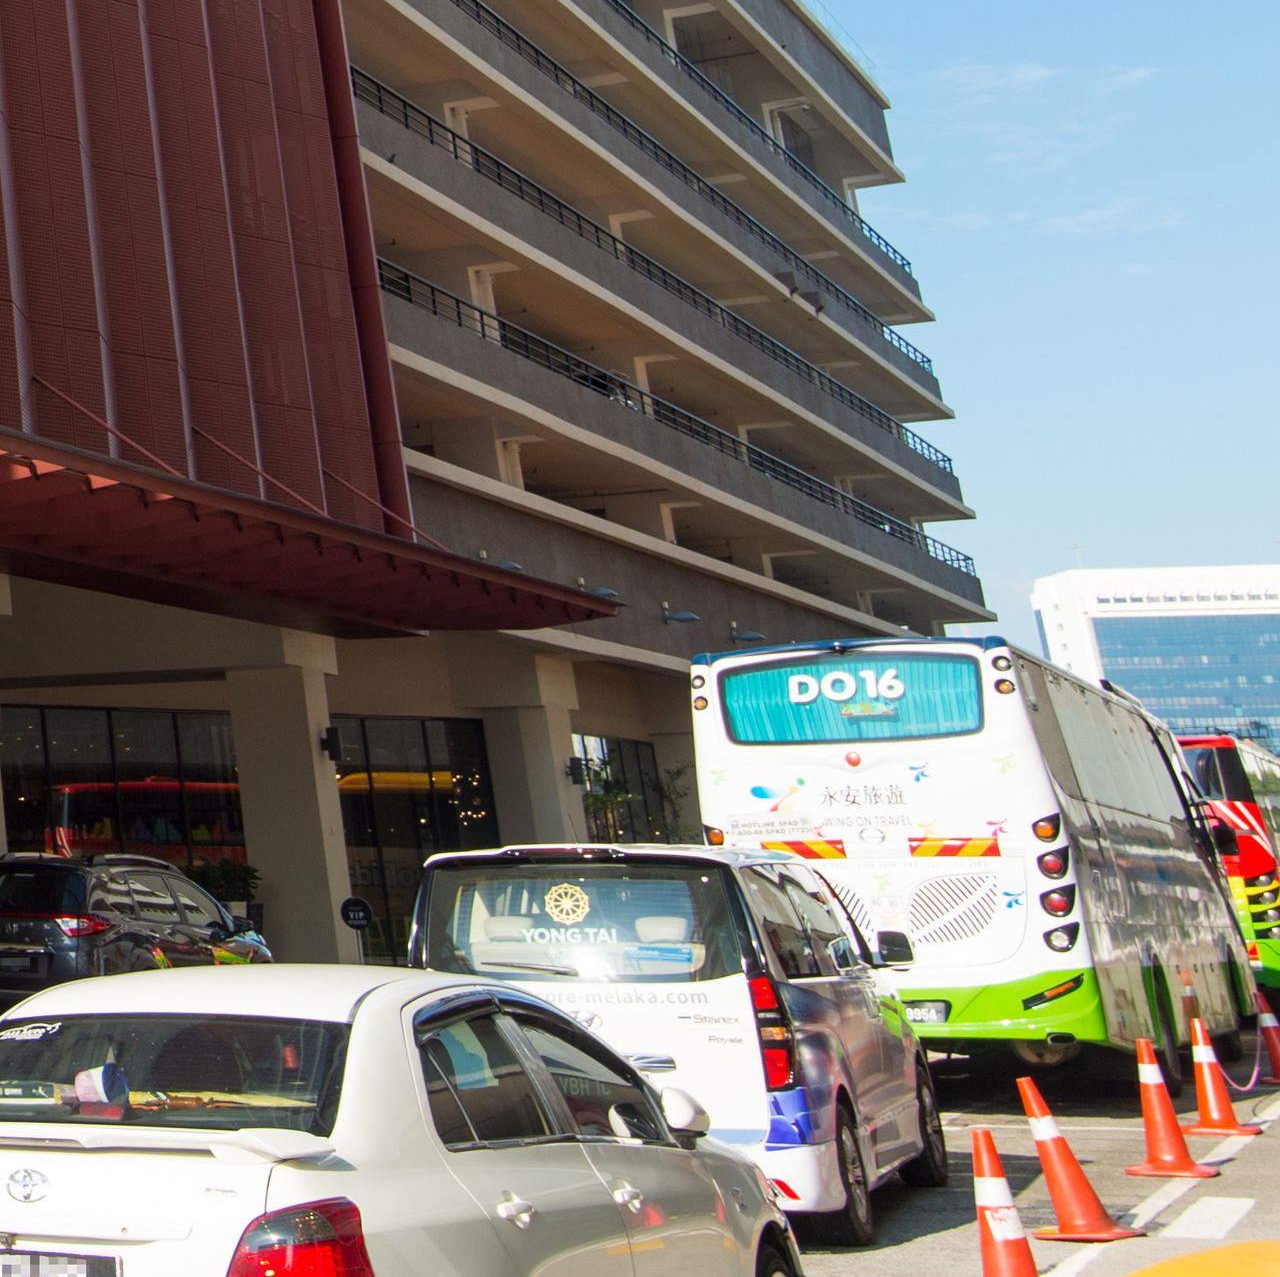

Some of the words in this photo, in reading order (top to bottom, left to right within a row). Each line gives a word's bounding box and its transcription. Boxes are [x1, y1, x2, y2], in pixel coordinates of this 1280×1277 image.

[825, 816, 853, 827] WING
[856, 816, 872, 826] ON
[874, 815, 912, 826] TRAVEL
[348, 911, 364, 919] VIP
[521, 927, 581, 943] YONG
[584, 928, 618, 943] TAI
